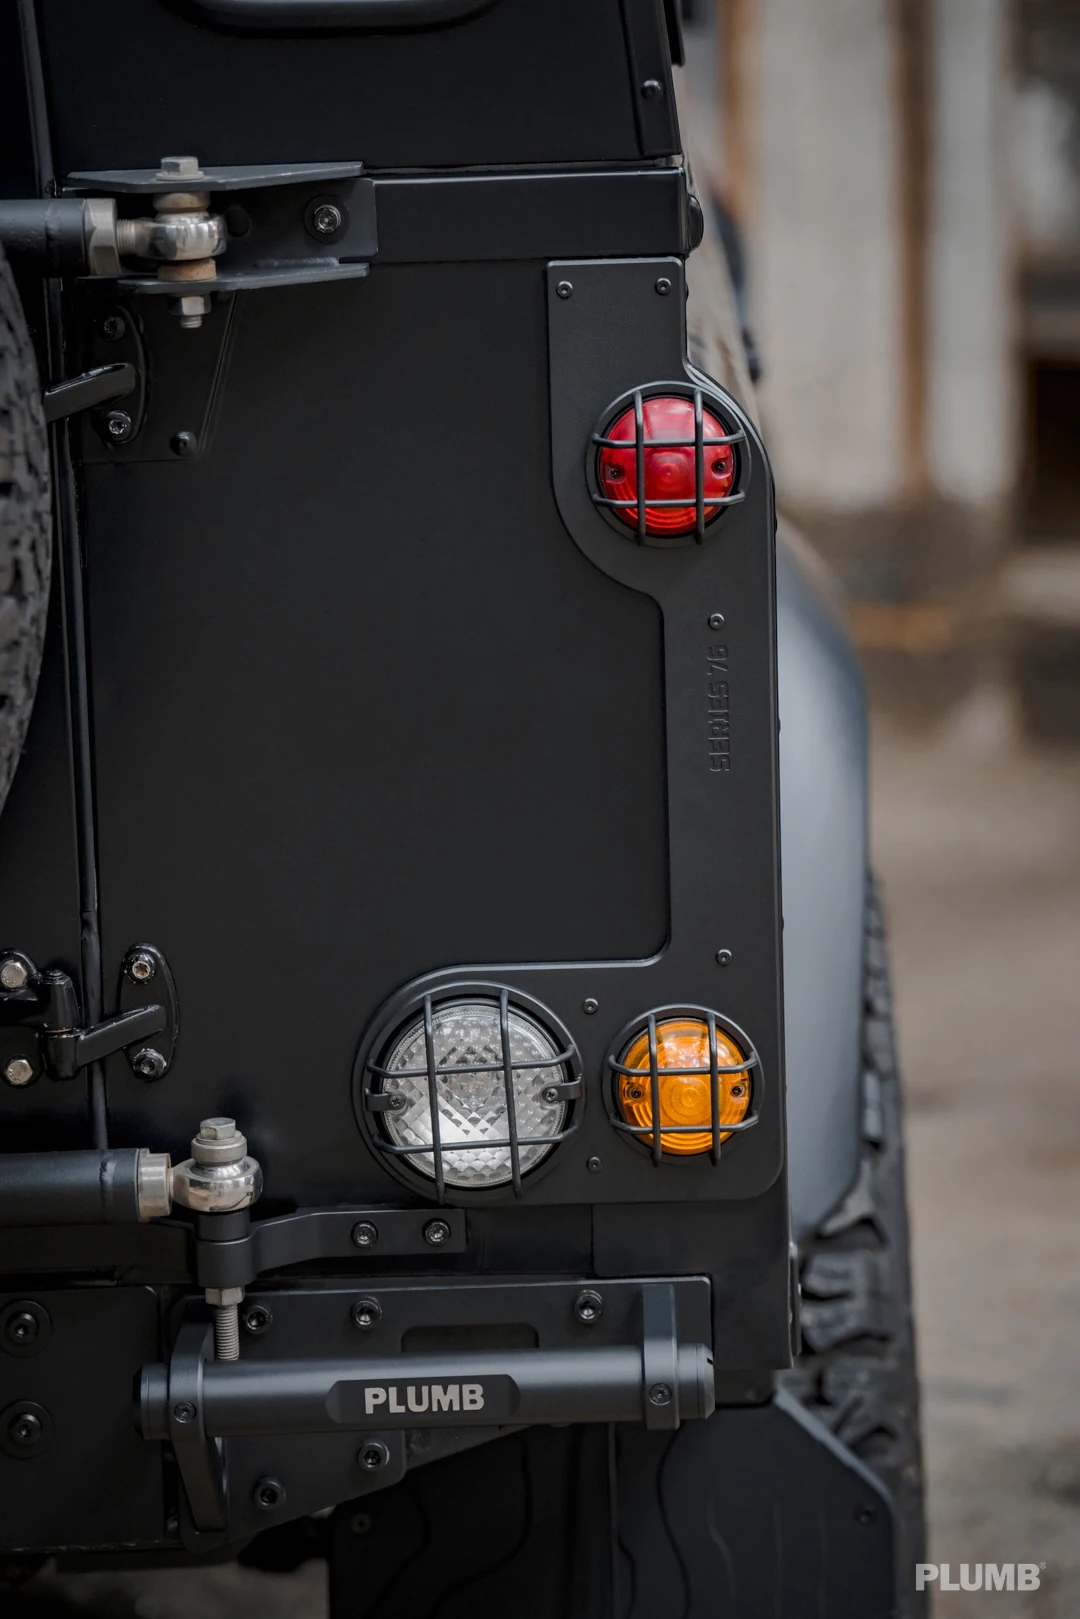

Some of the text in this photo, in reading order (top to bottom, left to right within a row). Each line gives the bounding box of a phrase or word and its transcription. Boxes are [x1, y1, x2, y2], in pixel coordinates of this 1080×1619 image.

[707, 645, 730, 771] SERIES 76
[364, 1384, 485, 1414] PLUMB
